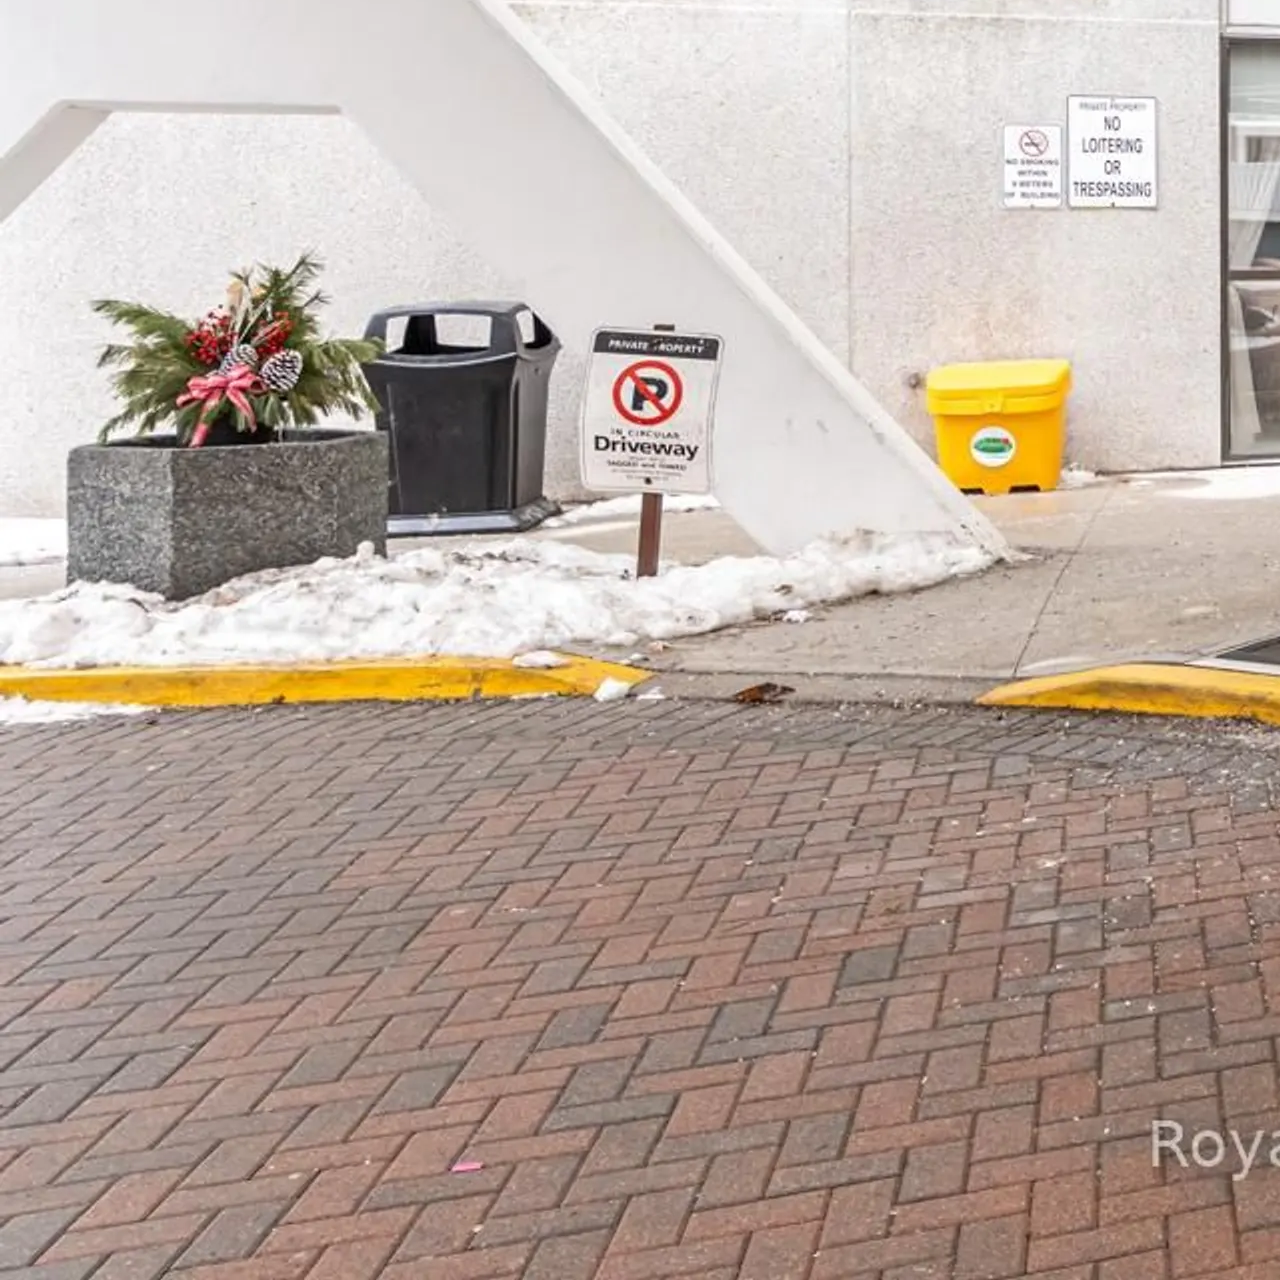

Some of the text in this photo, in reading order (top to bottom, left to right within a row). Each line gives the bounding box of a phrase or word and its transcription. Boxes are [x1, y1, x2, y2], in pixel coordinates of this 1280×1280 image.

[1078, 102, 1148, 112] PRIVATE PROPERTY
[1103, 116, 1121, 131] NO
[1082, 138, 1144, 154] LOITERING
[1104, 160, 1120, 174] OR
[1072, 182, 1152, 198] TRESPASSING
[608, 340, 650, 350] PRIVATE
[628, 430, 680, 438] CIRCULAR
[594, 434, 700, 462] Driveway
